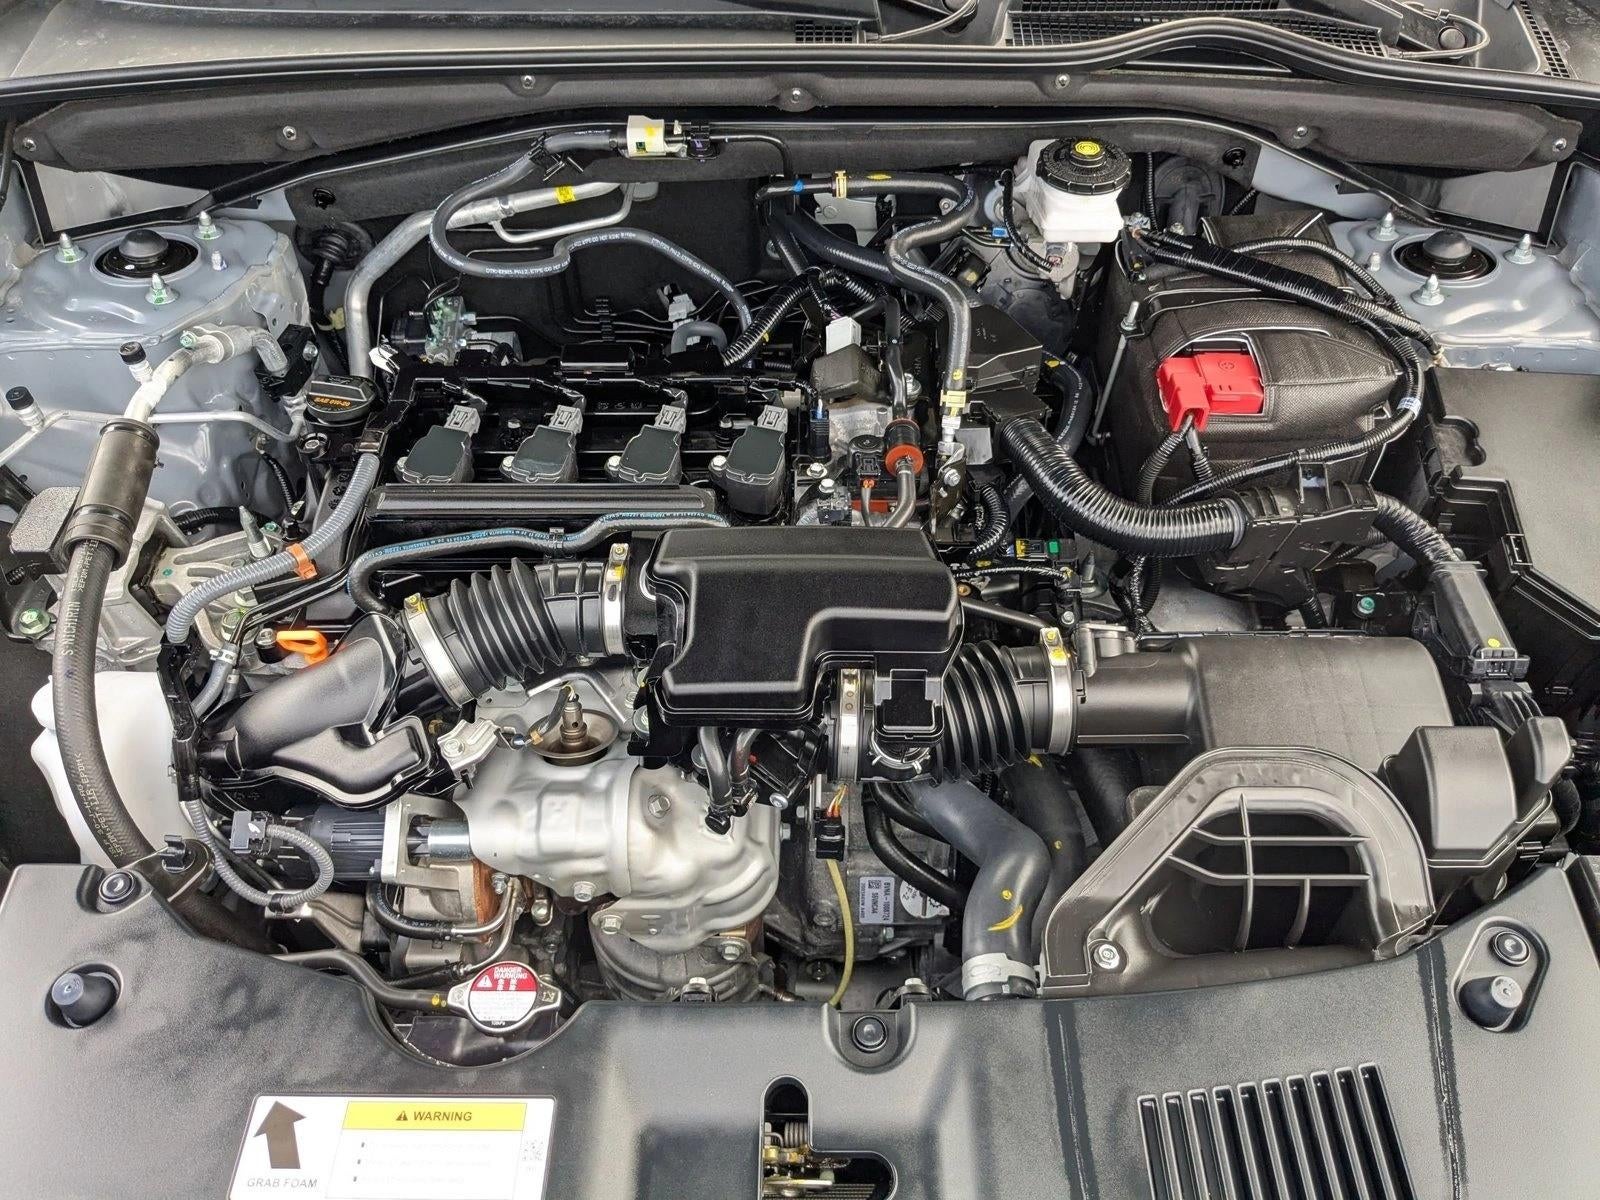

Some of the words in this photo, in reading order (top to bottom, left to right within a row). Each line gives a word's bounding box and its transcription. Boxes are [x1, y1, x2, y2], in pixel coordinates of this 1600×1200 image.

[413, 1111, 473, 1122] WARNING
[247, 1177, 280, 1189] GRAB
[283, 1177, 318, 1189] FOAM
